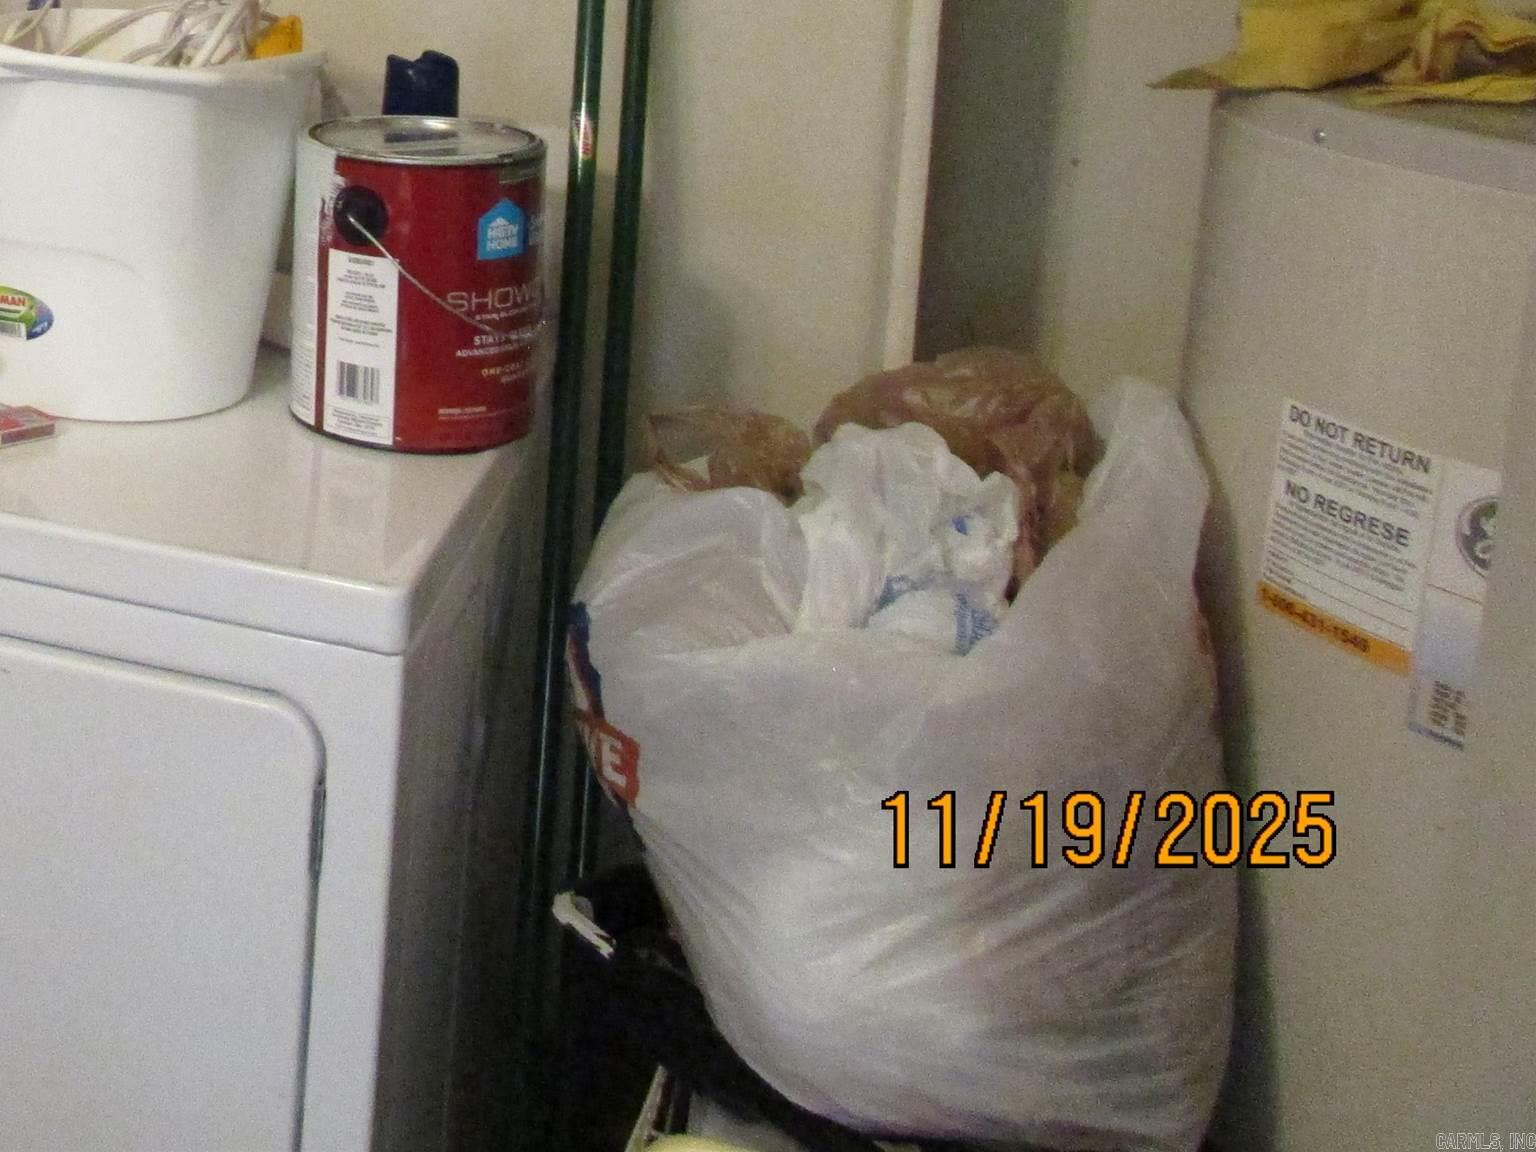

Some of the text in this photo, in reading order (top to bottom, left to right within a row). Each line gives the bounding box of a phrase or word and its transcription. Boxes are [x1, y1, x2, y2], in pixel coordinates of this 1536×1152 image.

[1289, 404, 1432, 474] DO NOT RETURN
[1284, 479, 1411, 547] NO REGRESE
